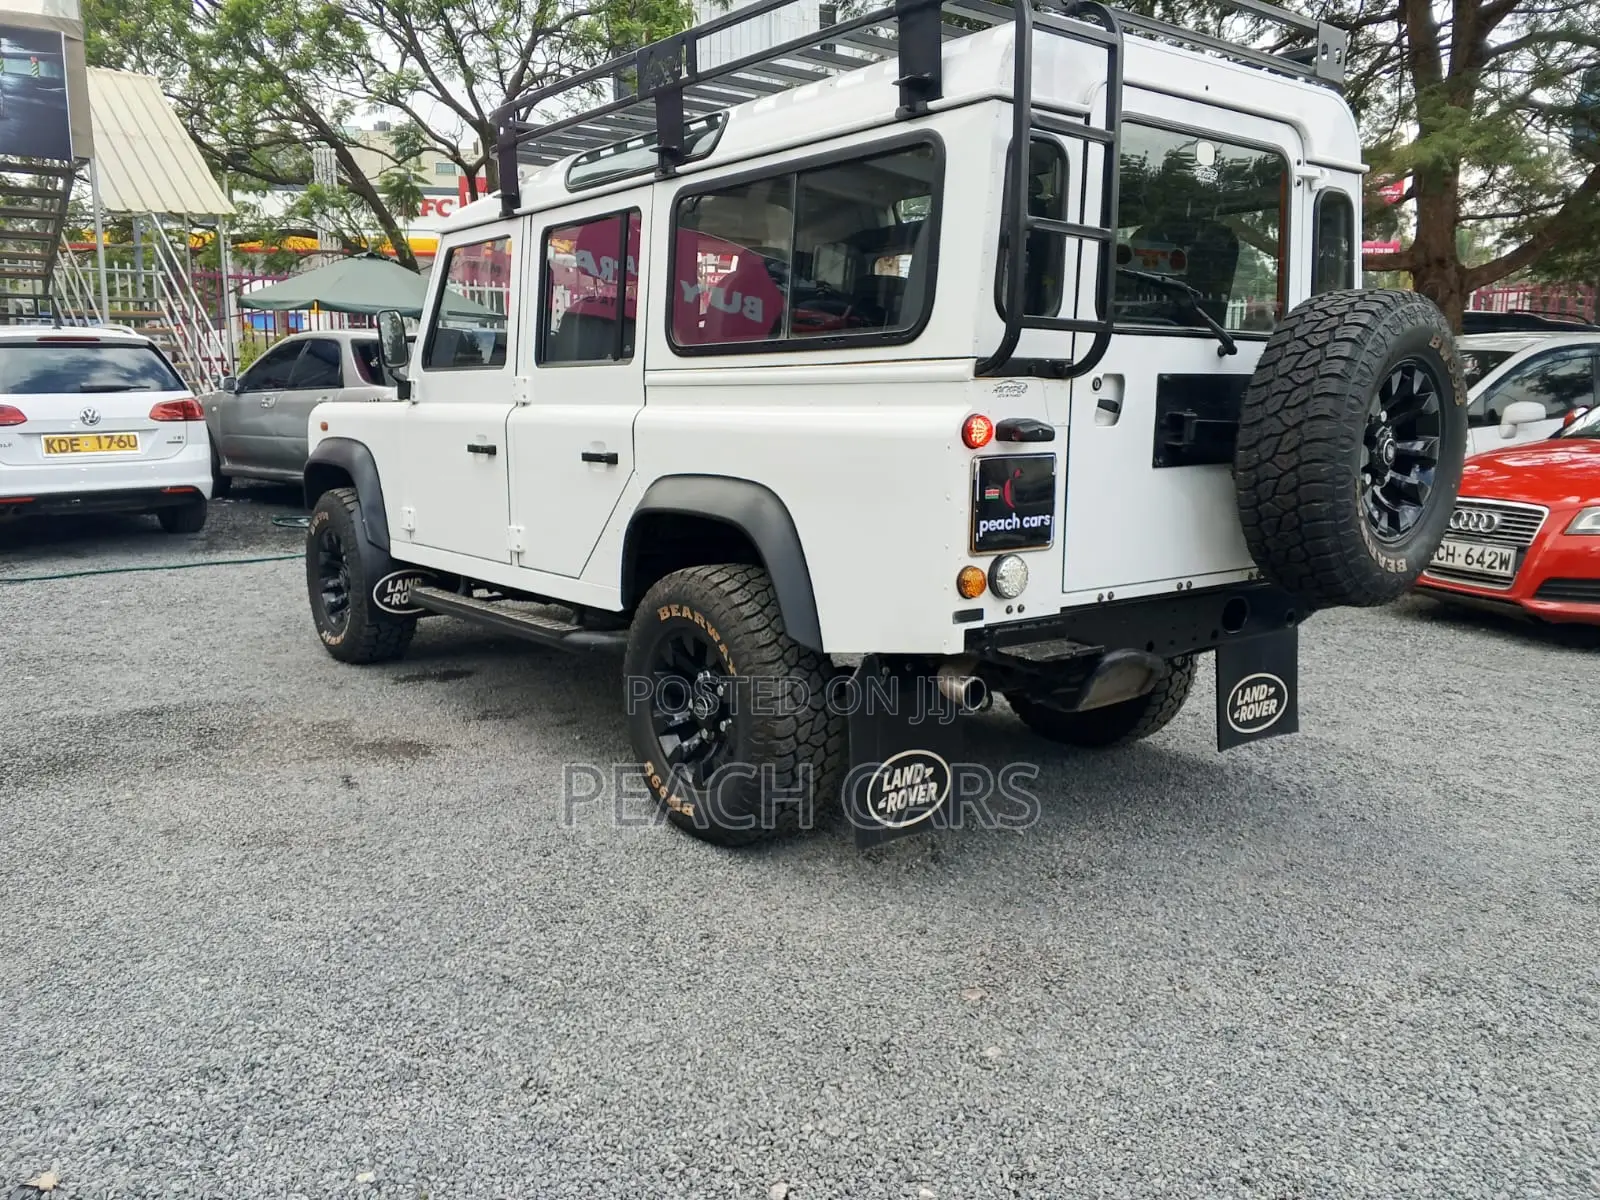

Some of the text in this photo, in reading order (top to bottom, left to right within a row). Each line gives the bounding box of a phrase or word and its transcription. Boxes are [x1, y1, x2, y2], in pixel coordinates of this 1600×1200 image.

[402, 199, 453, 217] FC
[44, 434, 138, 454] KDE 176U
[979, 512, 1051, 538] peach cars
[1433, 544, 1512, 571] CH 642W
[391, 590, 412, 605] RO
